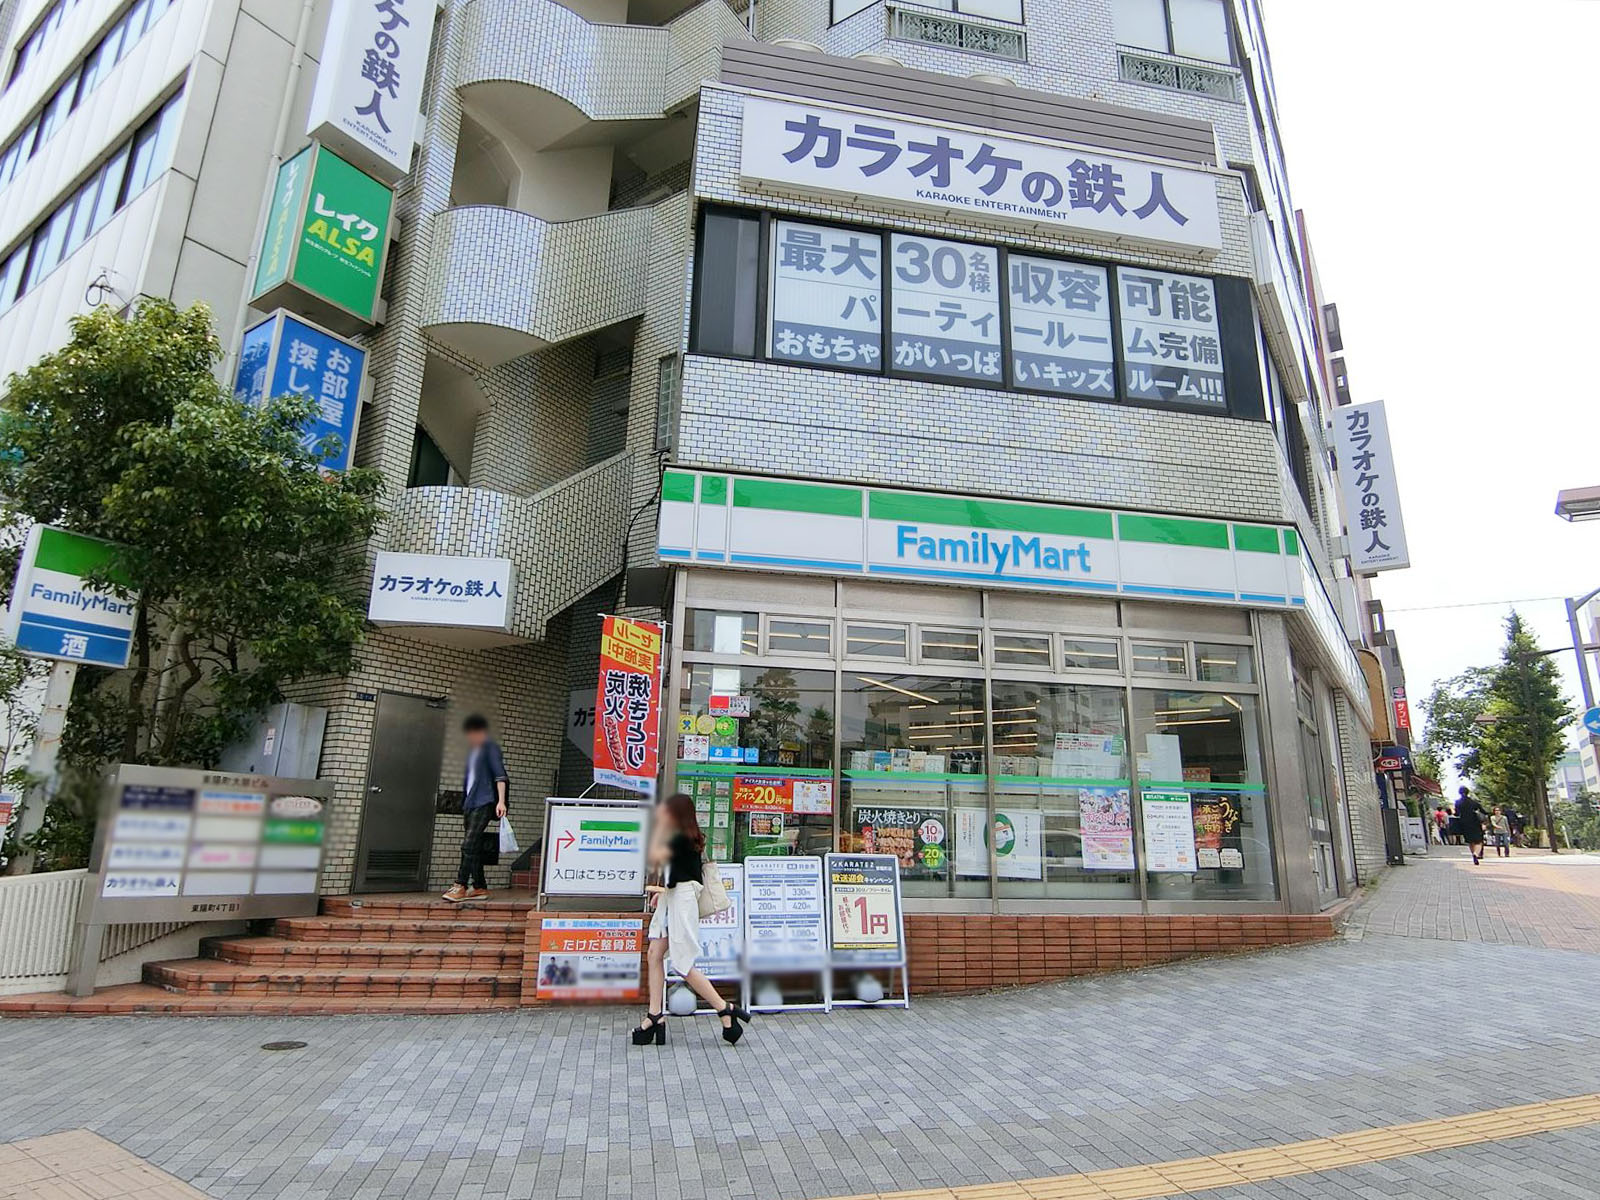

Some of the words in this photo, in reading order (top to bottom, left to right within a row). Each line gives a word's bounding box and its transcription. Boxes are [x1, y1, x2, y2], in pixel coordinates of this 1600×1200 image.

[354, 0, 410, 134] ケの鉄人
[782, 114, 1189, 227] カラオケの鉄人
[314, 192, 379, 241] レイク
[916, 189, 971, 206] KARAOKE
[974, 198, 1068, 221] ENTERTAINMENT
[307, 218, 374, 268] ALSA
[1346, 410, 1391, 553] カラオケの鉄人
[897, 525, 1092, 573] FamilyMart
[31, 583, 134, 616] FamilyMart
[379, 575, 503, 598] カラオケの鉄人
[59, 633, 89, 658] 酒
[858, 809, 920, 824] 炭火焼きとり
[553, 869, 639, 881] 入口はこちらです
[562, 939, 637, 951] たけだ整骨院
